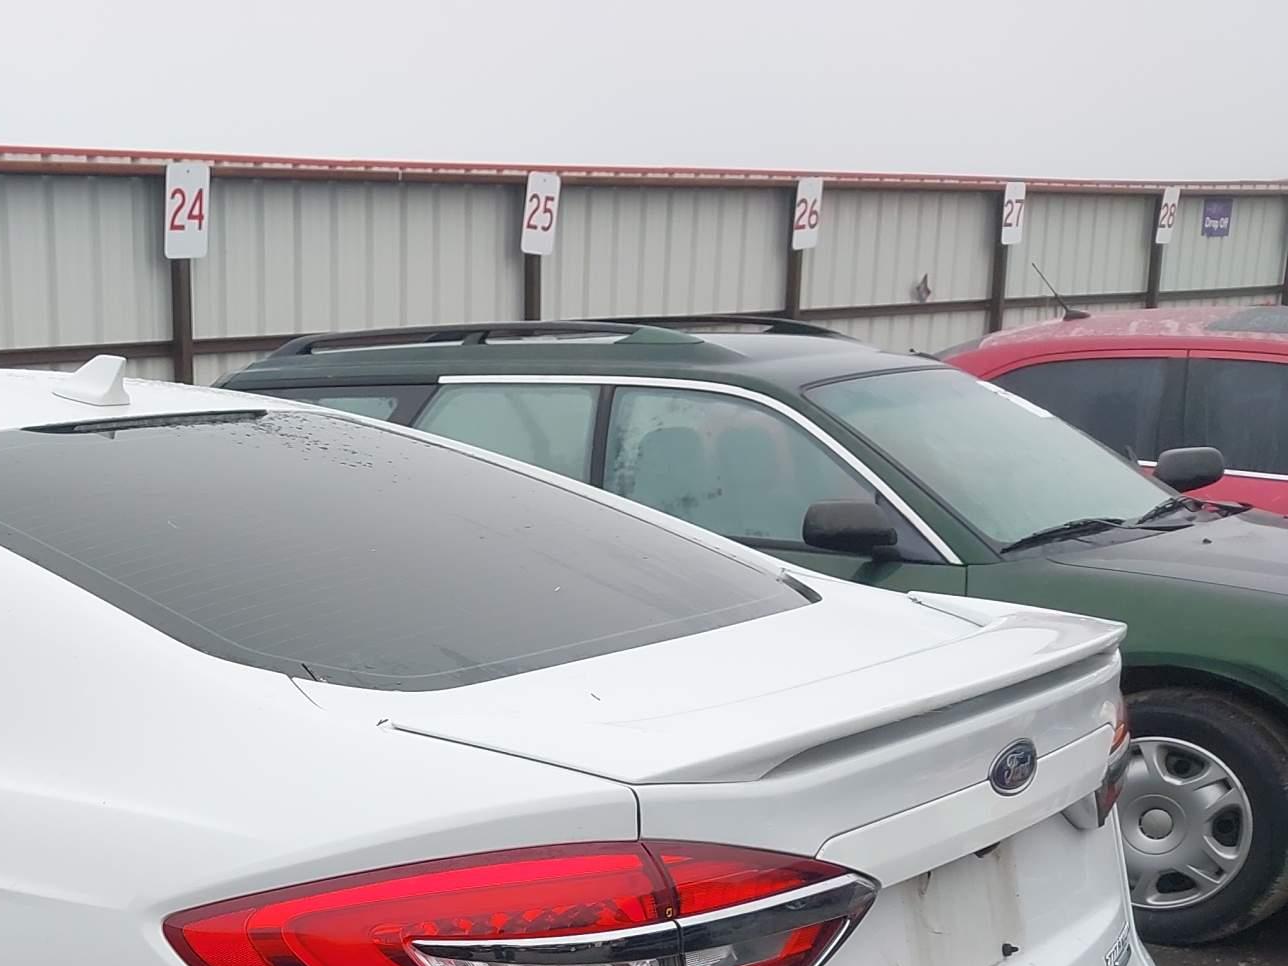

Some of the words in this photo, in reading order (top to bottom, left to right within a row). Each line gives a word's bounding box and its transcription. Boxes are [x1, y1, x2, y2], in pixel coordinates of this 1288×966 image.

[169, 187, 205, 232] 24
[526, 193, 555, 232] 25
[794, 198, 819, 230] 26
[1003, 199, 1025, 228] 27
[1158, 203, 1177, 228] 28
